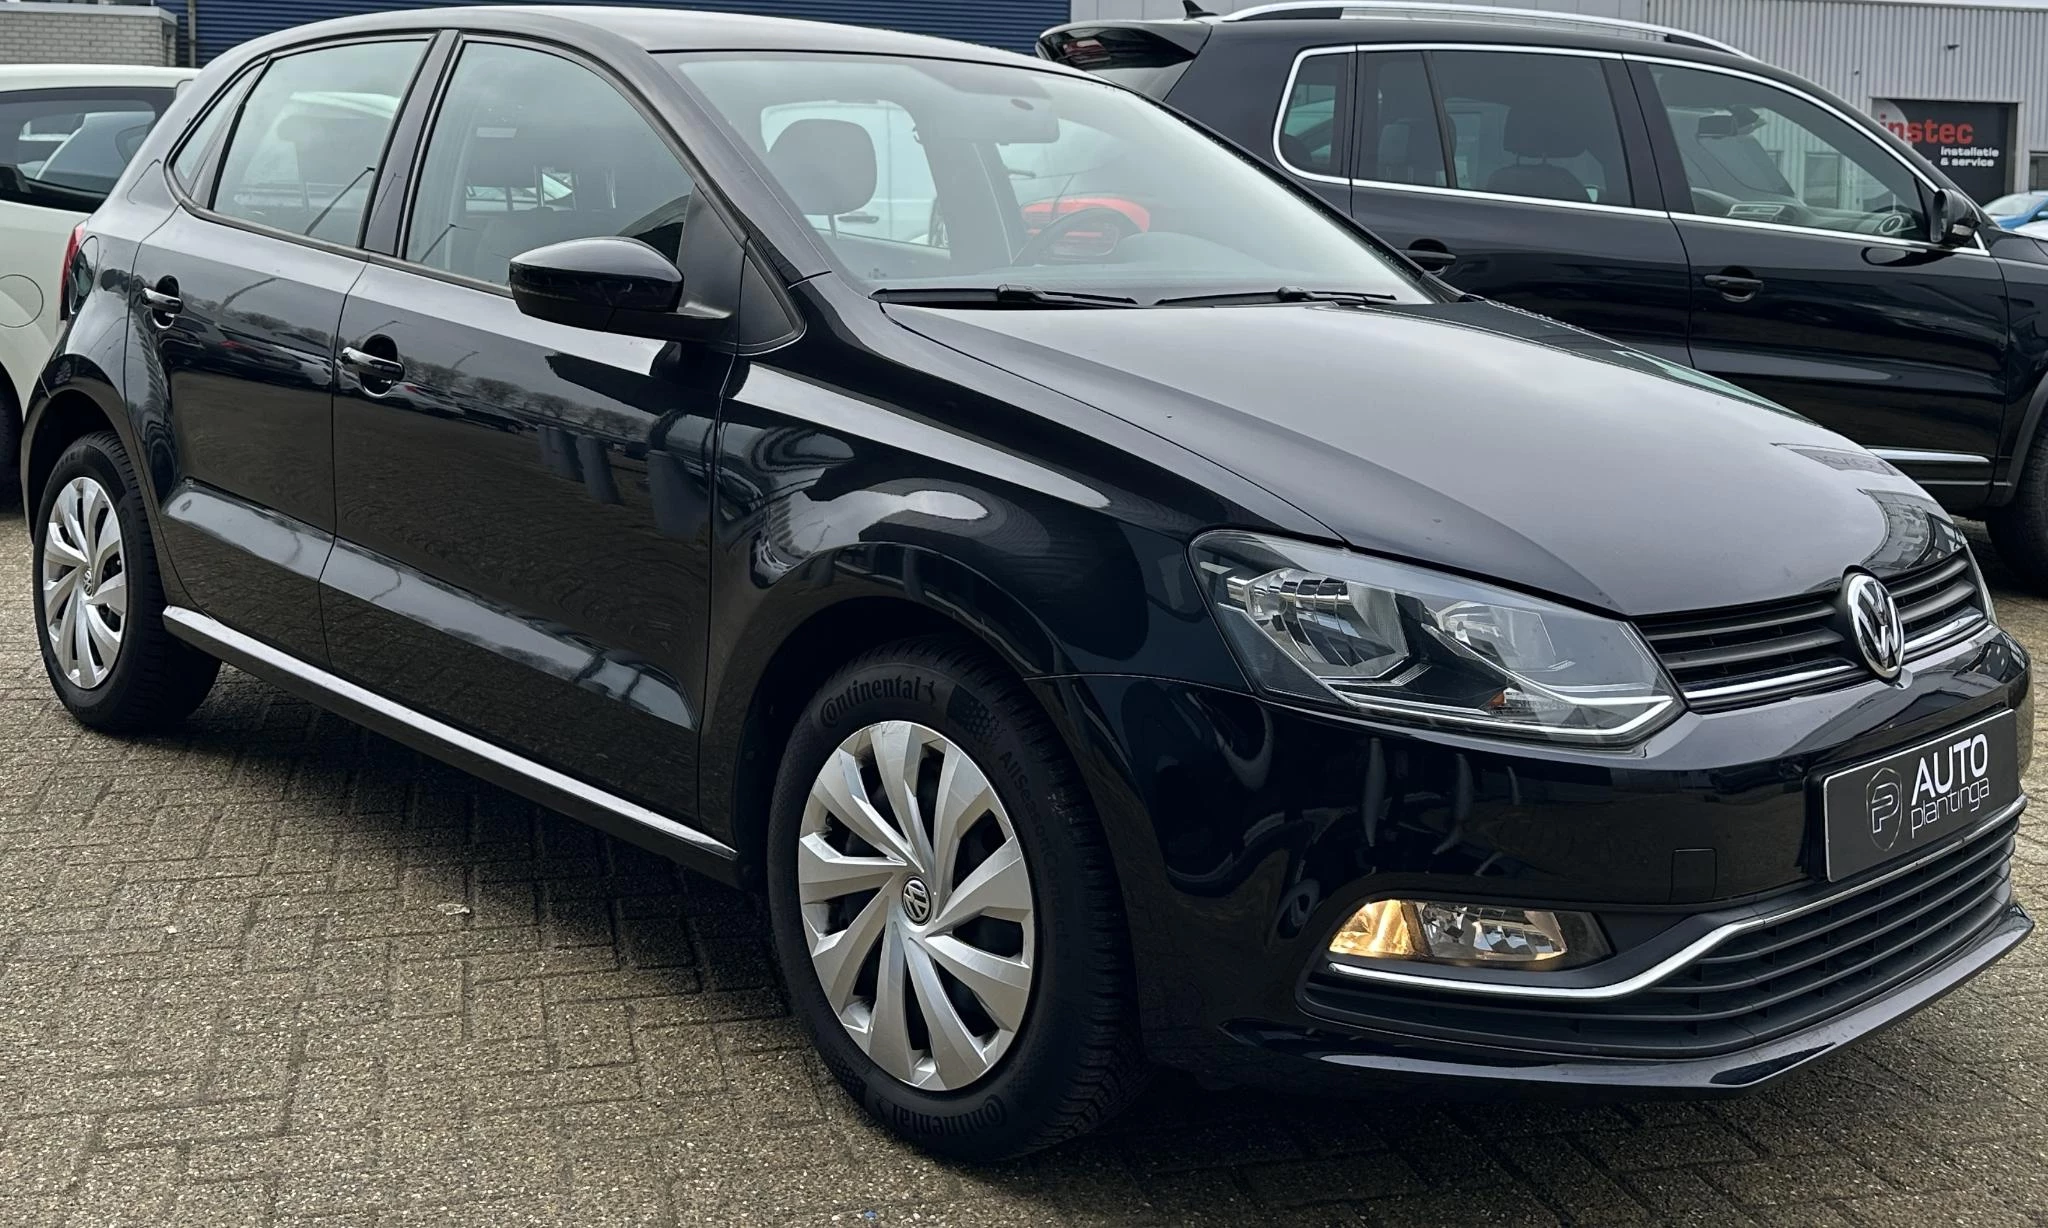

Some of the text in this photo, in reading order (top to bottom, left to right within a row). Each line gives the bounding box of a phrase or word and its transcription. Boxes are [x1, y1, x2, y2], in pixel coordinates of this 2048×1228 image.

[1940, 146, 2000, 158] installatie
[1940, 157, 1949, 167] &
[1951, 158, 1995, 167] service
[820, 674, 921, 728] Continental
[1911, 733, 1989, 806] AUTO
[1910, 777, 1990, 839] plantinga
